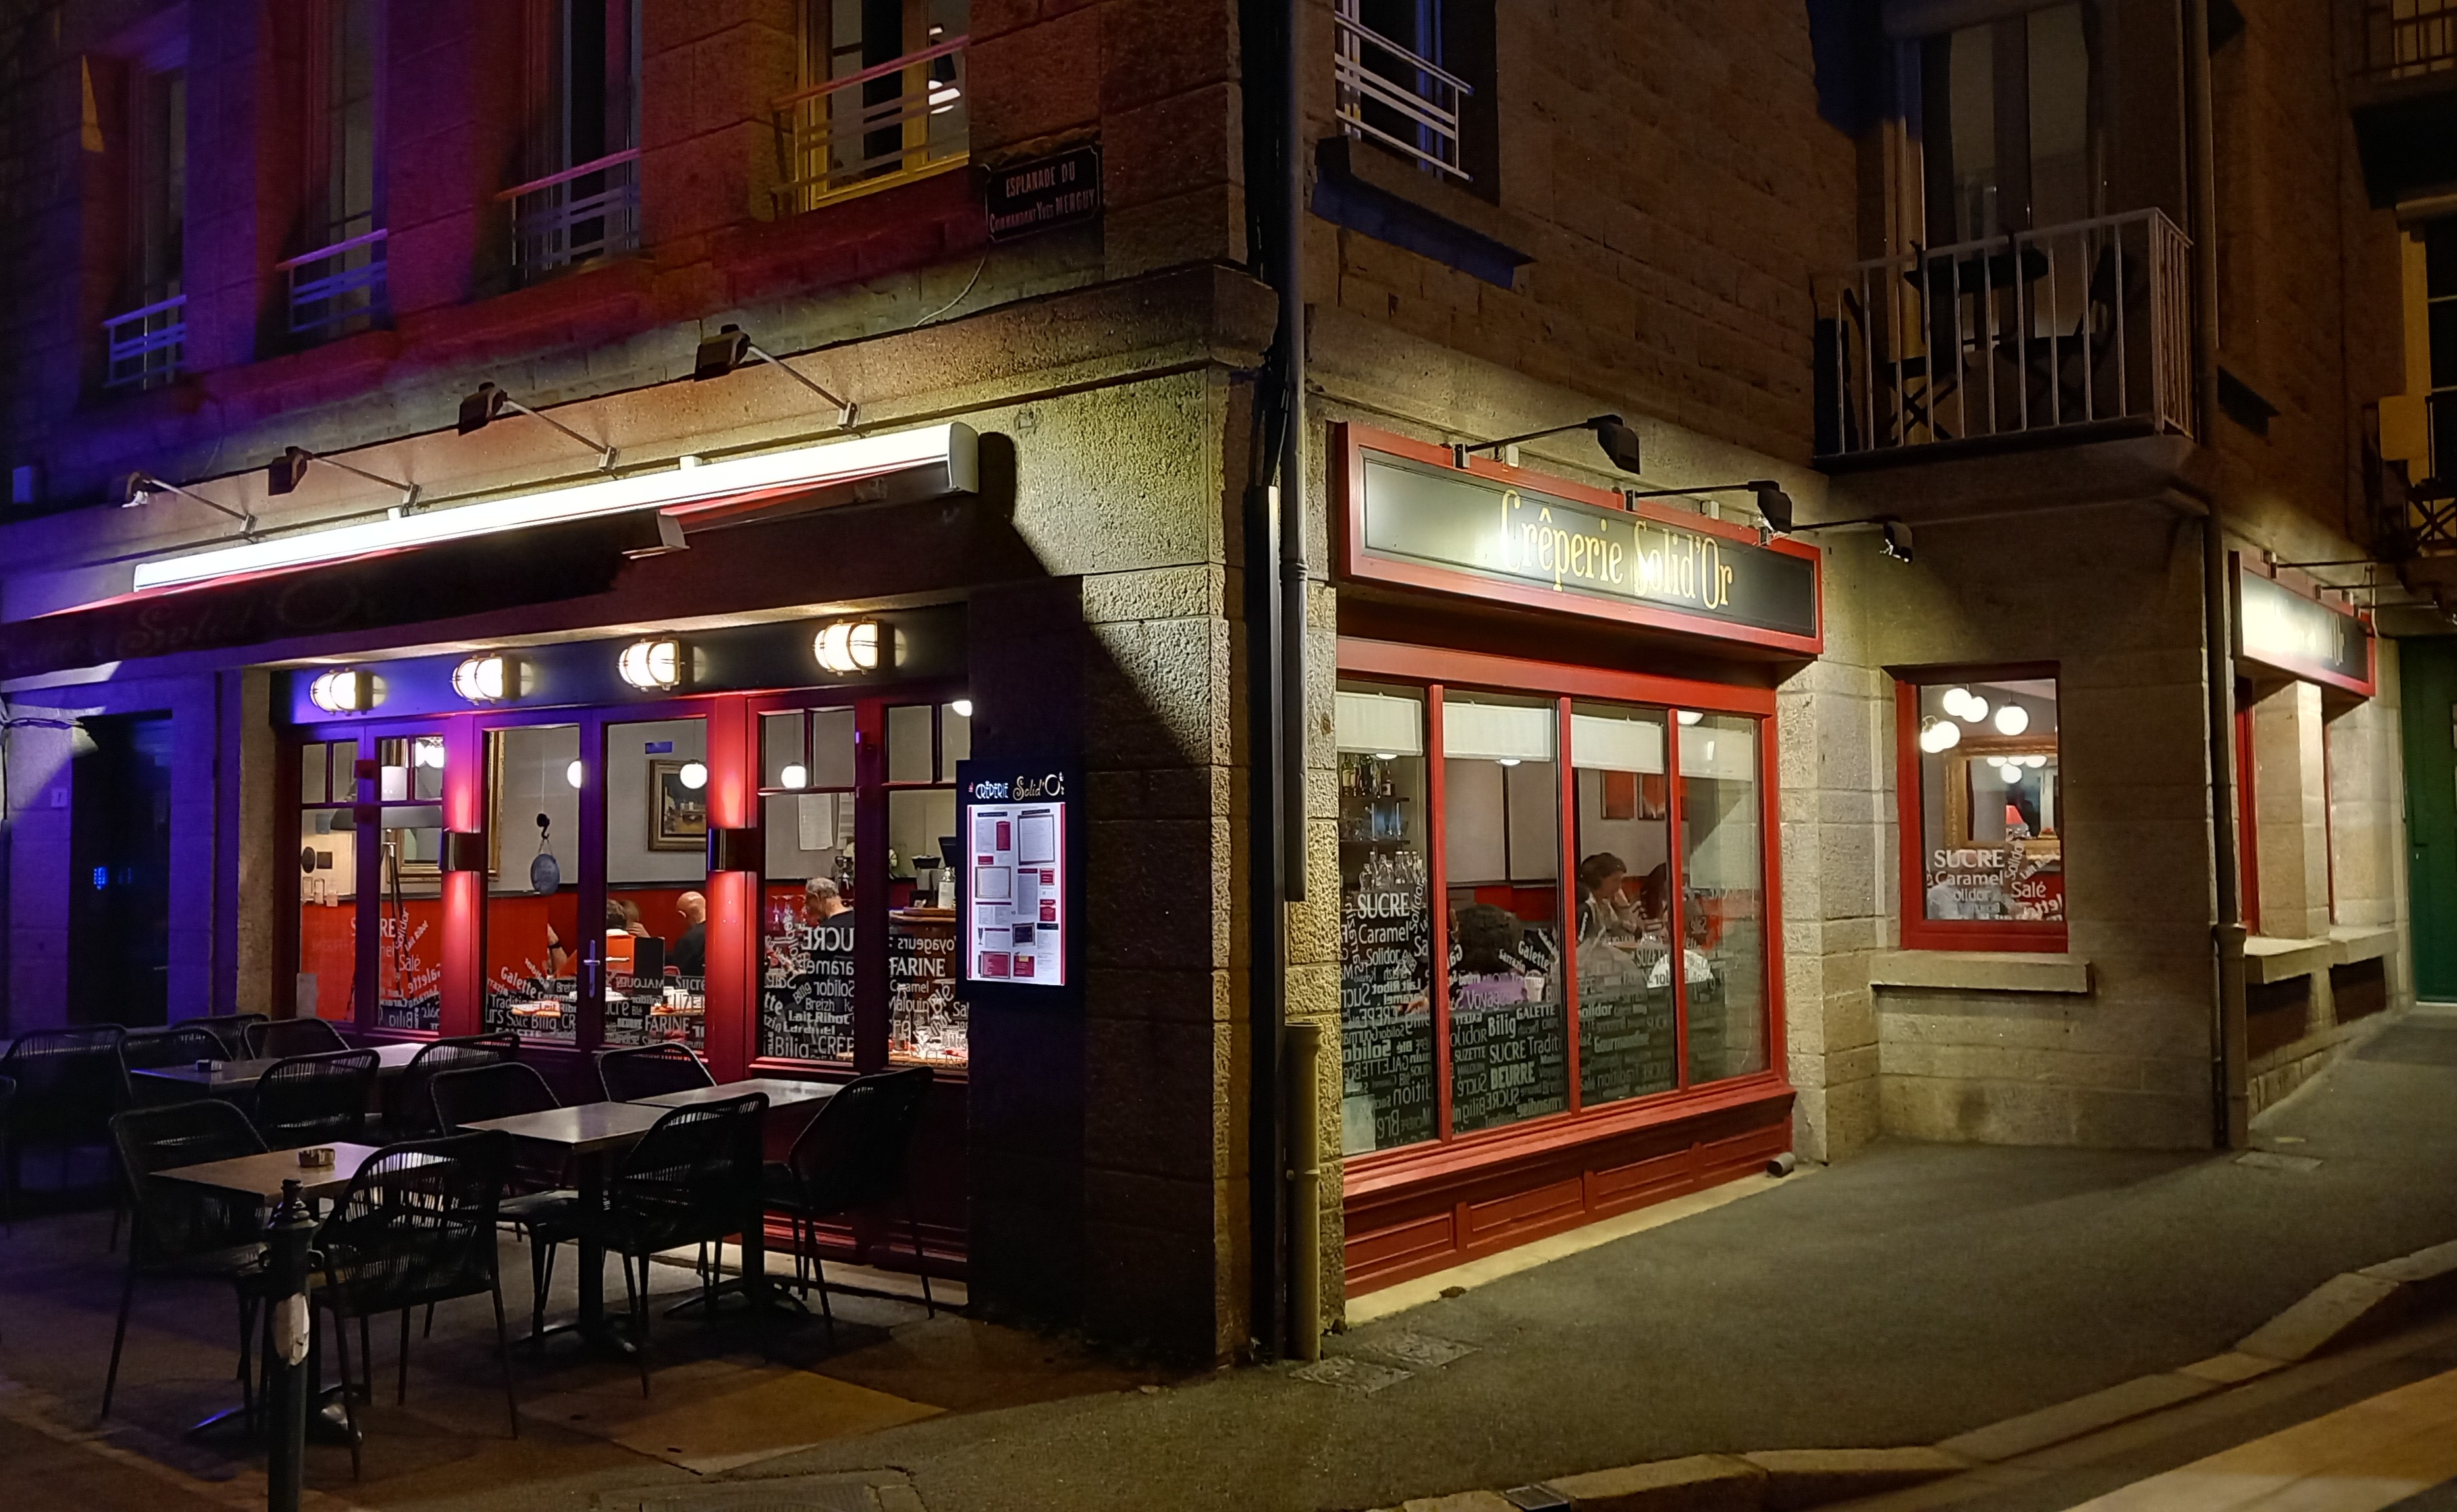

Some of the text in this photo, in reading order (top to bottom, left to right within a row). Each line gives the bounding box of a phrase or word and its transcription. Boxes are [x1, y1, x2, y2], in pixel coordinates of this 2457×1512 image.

[1006, 161, 1075, 198] ESPLANADE DU
[1501, 489, 1733, 610] Crêperie Solid'Or
[1933, 849, 2005, 868] SUCRE
[1935, 869, 2004, 886] Caramel
[2011, 880, 2047, 899] Salé
[1357, 892, 1410, 919] SUCRE
[1409, 878, 1425, 934] Solidor
[1359, 920, 1409, 944] Caramel
[1366, 946, 1401, 967] Solidor
[1499, 948, 1526, 975] Sarrazin
[1518, 940, 1550, 971] Galette
[890, 957, 946, 977] FARINE
[500, 966, 537, 998] Galette
[792, 982, 812, 1004] Bilig
[605, 1001, 630, 1016] ucre
[805, 997, 835, 1012] Breizh
[1516, 1004, 1556, 1021] GALETTE
[1580, 1002, 1613, 1018] olidor
[645, 1015, 690, 1035] FARINE
[1488, 1013, 1517, 1039] Bilig
[1454, 1046, 1487, 1063] SUZETTE
[1489, 1040, 1526, 1064] SUCRE
[1490, 1061, 1536, 1091] BEURRE
